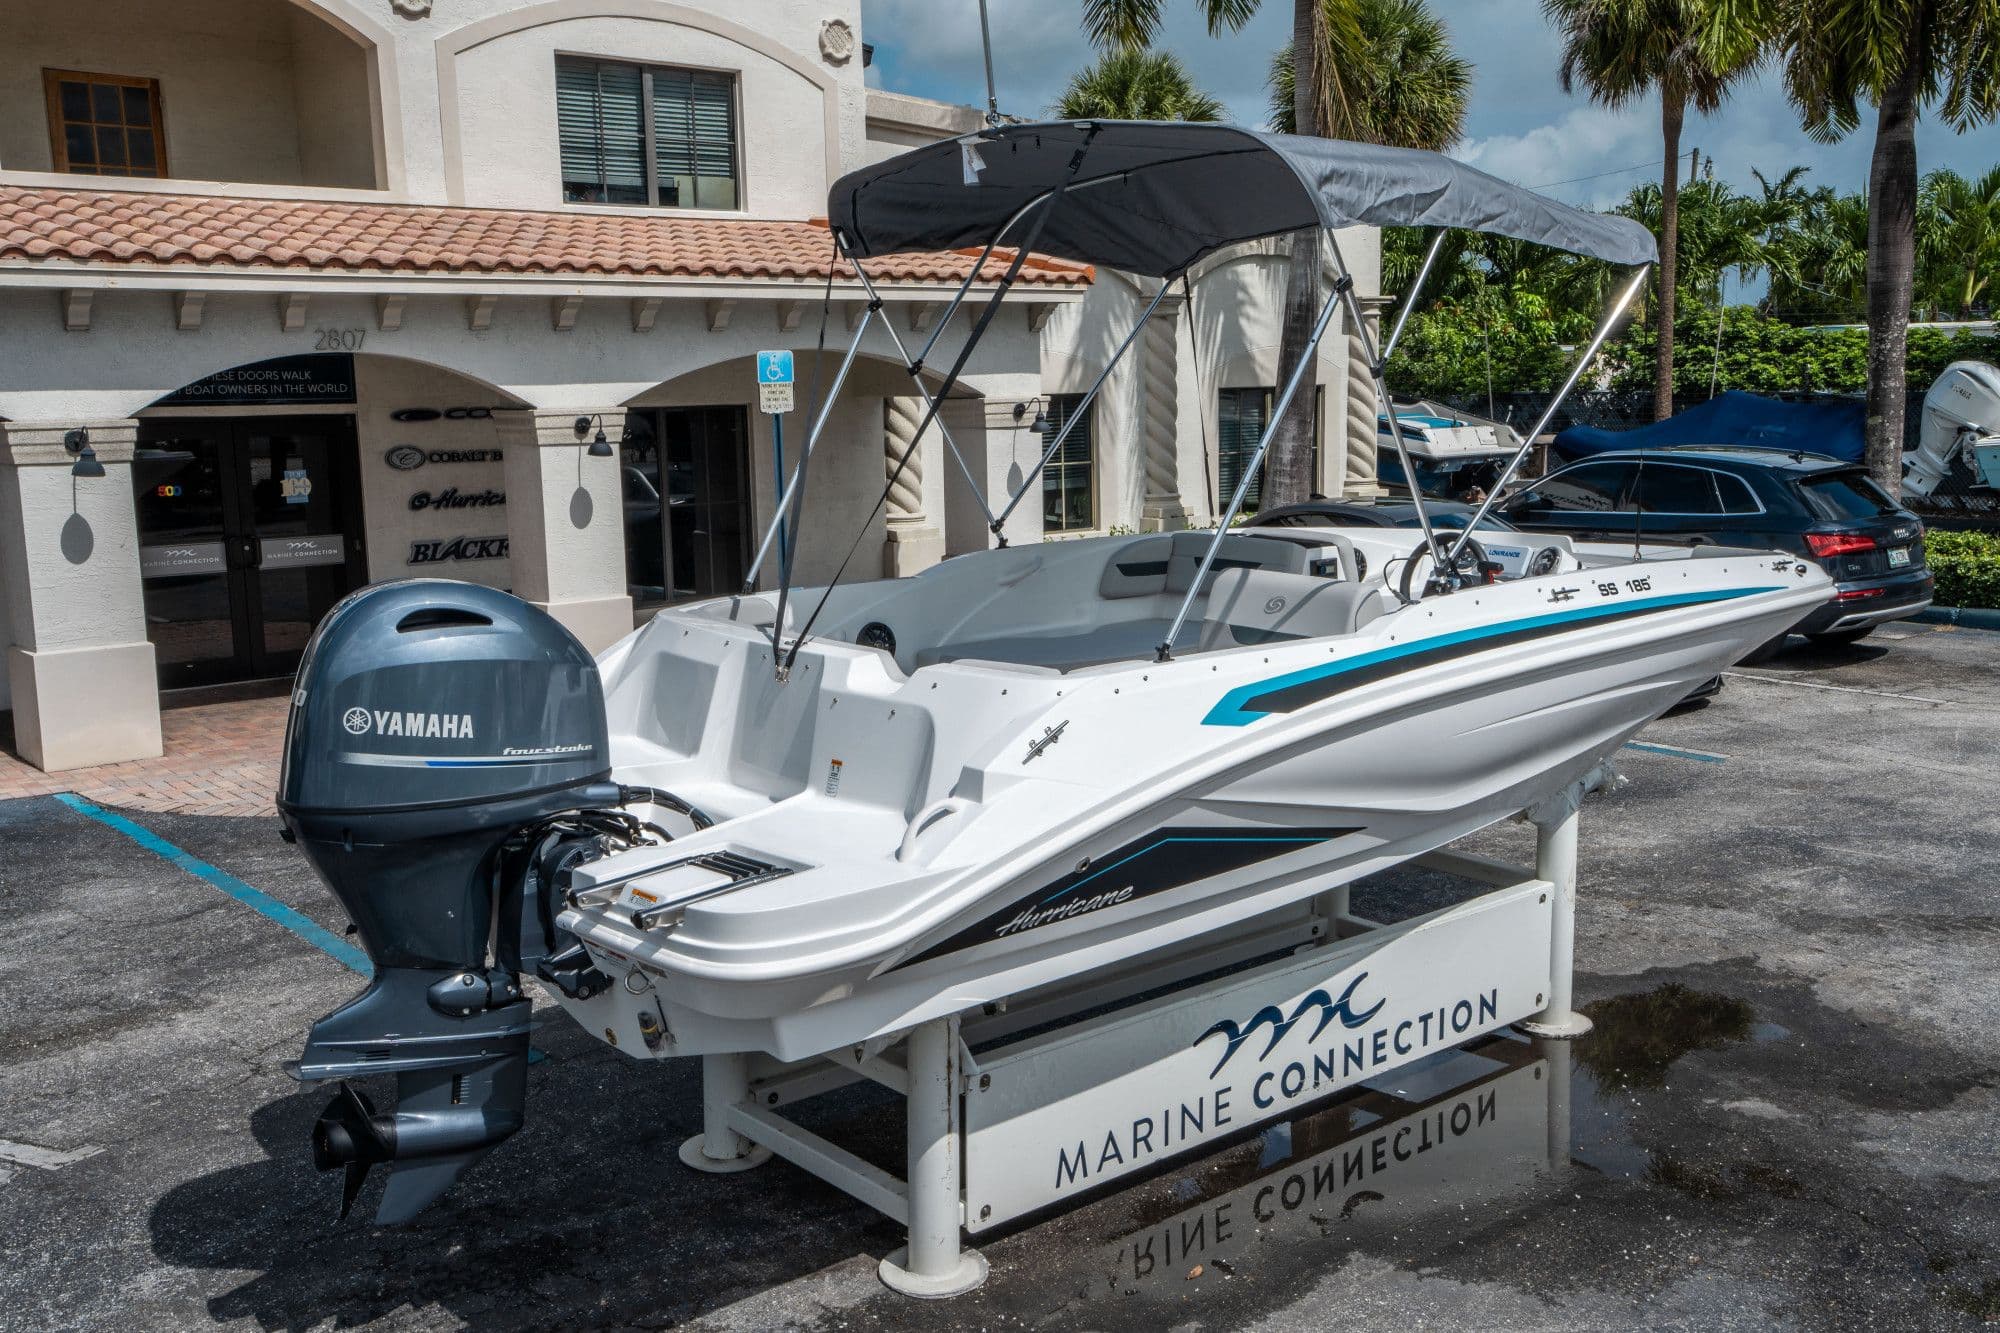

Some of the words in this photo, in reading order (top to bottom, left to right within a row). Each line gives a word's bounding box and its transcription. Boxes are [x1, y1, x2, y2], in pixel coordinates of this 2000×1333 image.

[313, 327, 367, 350] 2807
[238, 370, 279, 380] DOORS
[281, 369, 312, 380] WALK
[185, 384, 215, 395] BOAT
[217, 384, 268, 394] OWNERS
[270, 384, 282, 394] IN
[284, 383, 305, 393] THE
[307, 383, 348, 393] WORLD
[429, 449, 485, 463] COBALT
[158, 485, 181, 497] 500
[294, 548, 338, 557] CONNECTION
[172, 556, 220, 566] CONNECTION
[1597, 582, 1620, 597] SS
[1625, 578, 1652, 593] 185
[373, 710, 475, 739] YAMAHA
[995, 884, 1135, 937] Hurricane
[1054, 1085, 1233, 1190] MARINE
[1252, 988, 1498, 1110] CONNECTION
